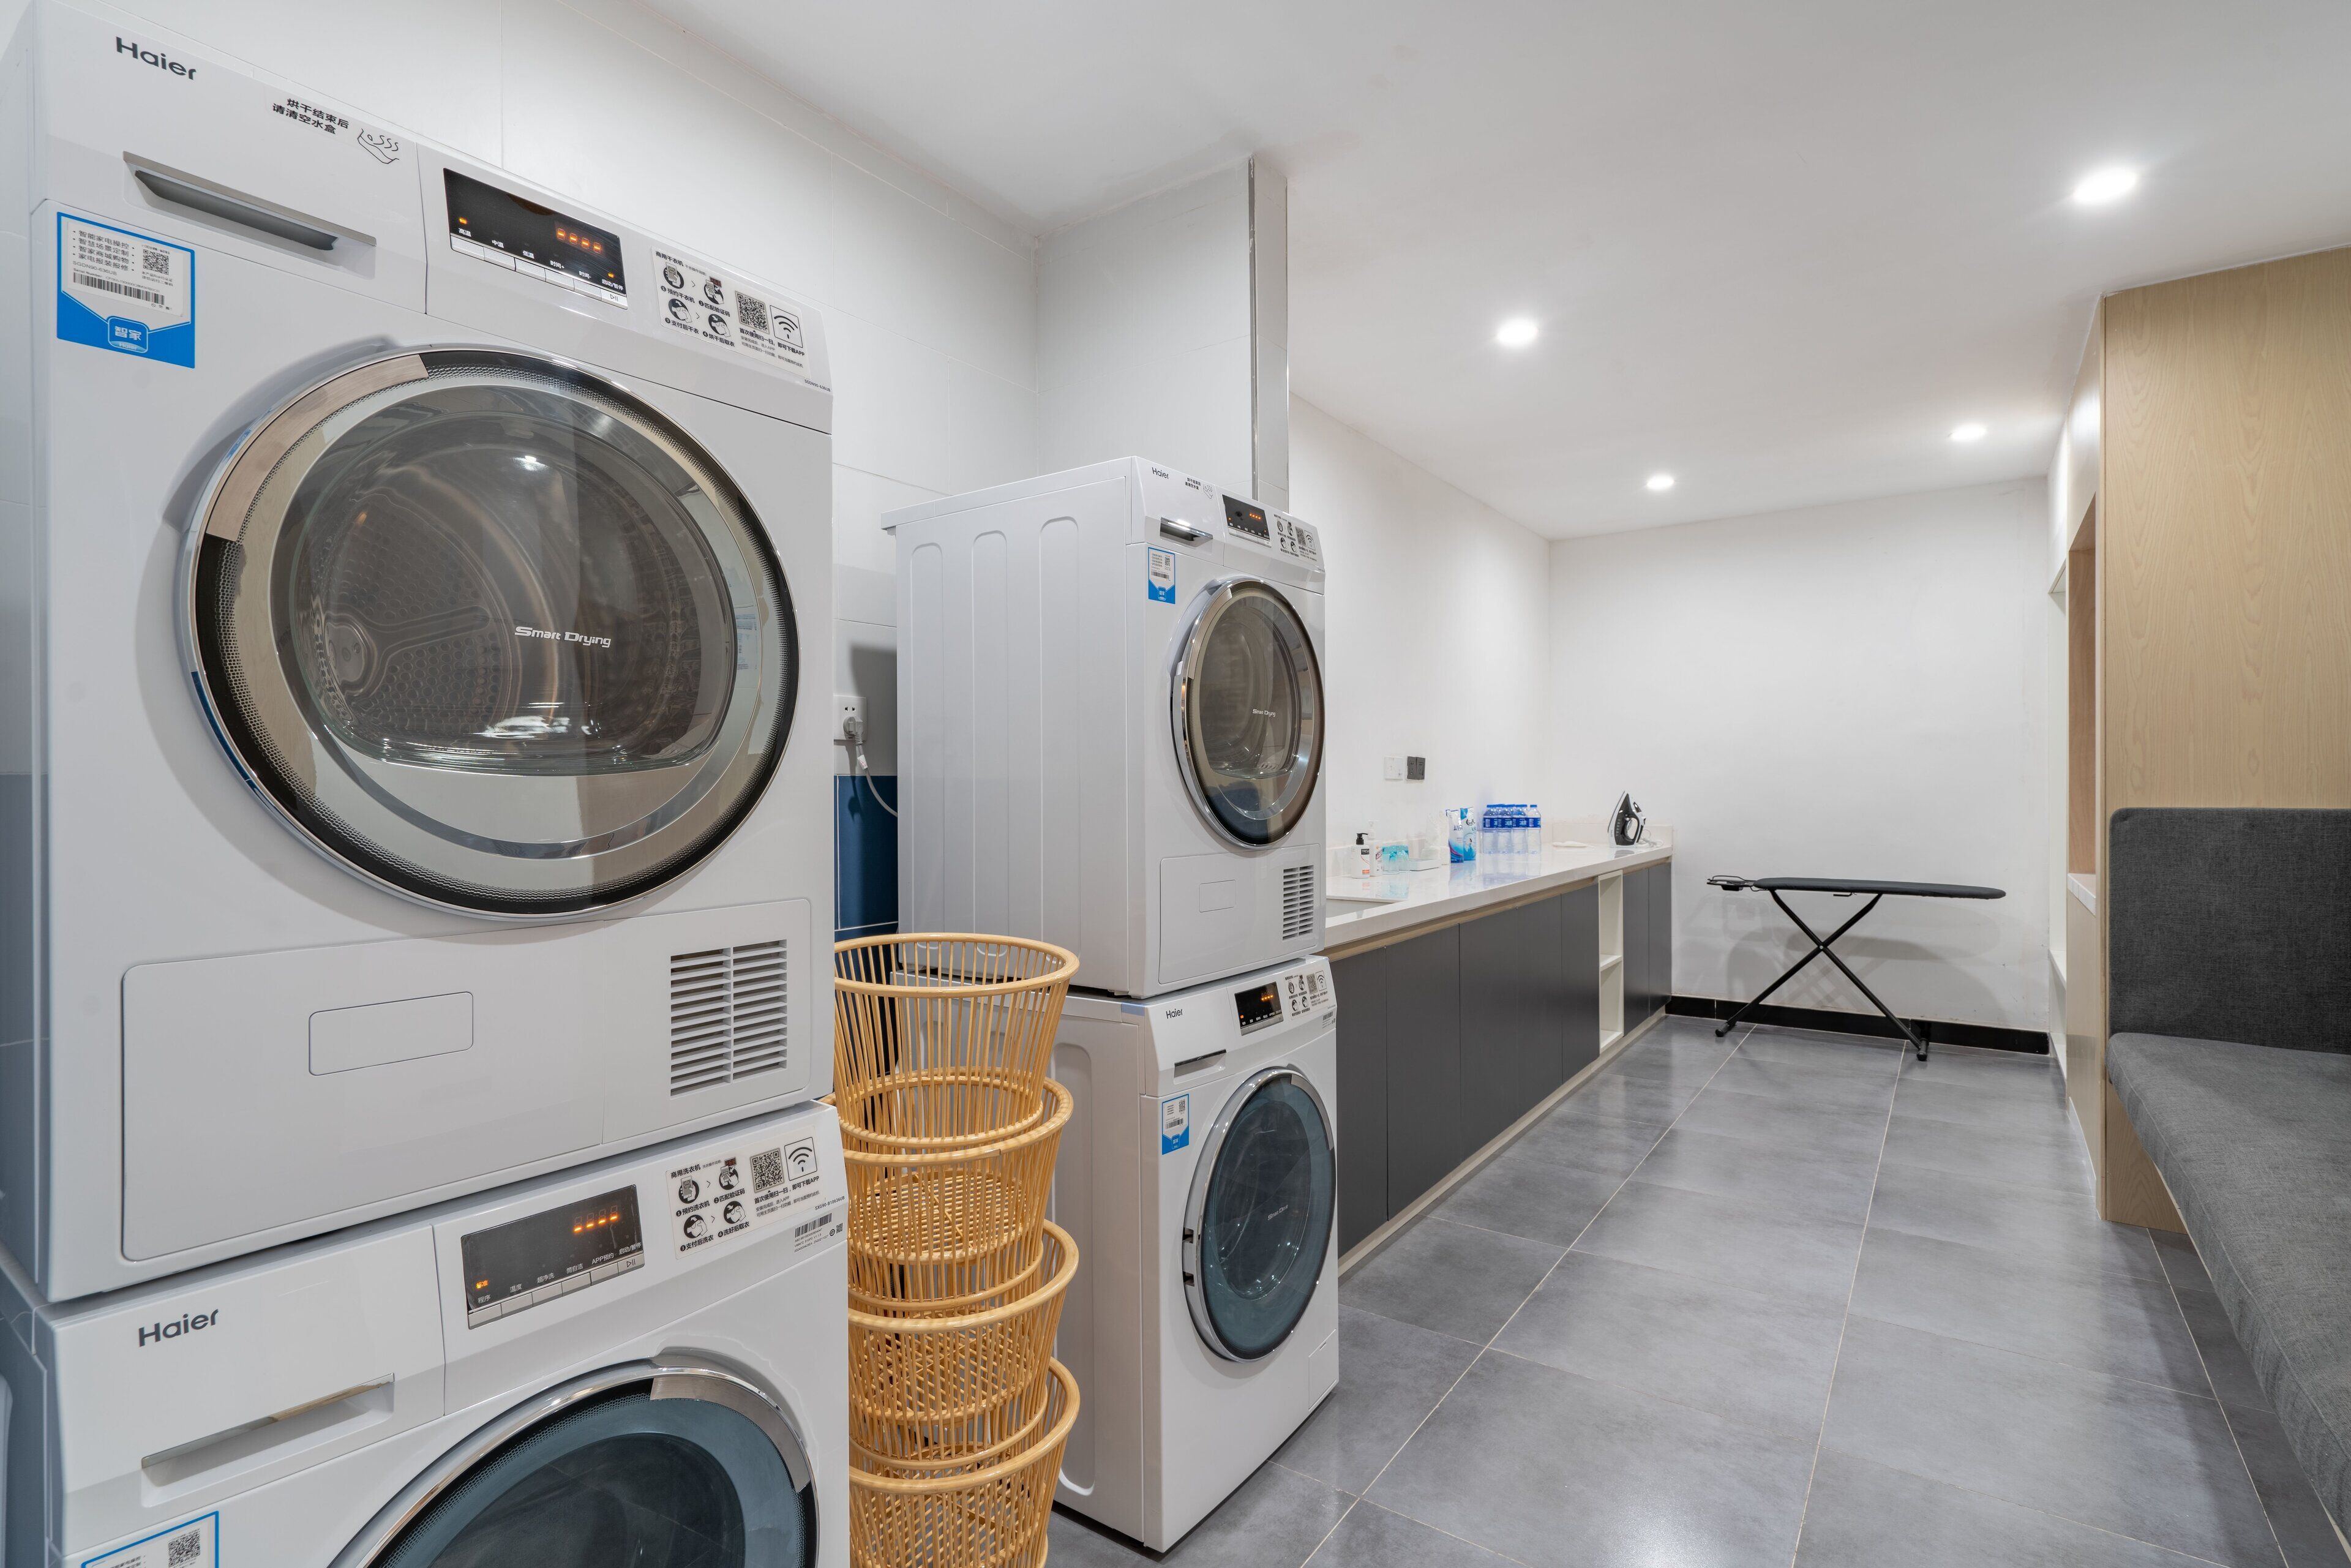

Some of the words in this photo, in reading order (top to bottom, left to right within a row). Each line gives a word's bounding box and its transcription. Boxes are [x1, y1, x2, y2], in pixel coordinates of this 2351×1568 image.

[116, 37, 197, 80] Haier
[272, 103, 337, 134] 请清空水盒
[286, 98, 350, 129] 烘干结束后
[78, 230, 129, 249] 智能家电操控
[459, 228, 471, 237] 高温
[78, 238, 129, 257] 智慧场景定制
[492, 239, 504, 249] 中温
[78, 246, 129, 264] 智家商城购物
[522, 250, 534, 259] 低温
[656, 251, 684, 267] 商用干衣机
[78, 253, 129, 271] 家电报装报修
[602, 279, 624, 291] 启动/暂停
[667, 288, 695, 304] 预约干衣机
[704, 302, 730, 317] 匹配验证码
[114, 326, 141, 340] 智家
[671, 320, 699, 334] 支付后干衣
[709, 334, 735, 347] 烘干后取衣
[1152, 467, 1169, 479] Haier
[514, 626, 561, 640] Smart
[564, 631, 611, 648] Drying
[1166, 1008, 1183, 1019] Haier
[670, 1164, 701, 1179] 商用洗衣机
[719, 1188, 745, 1202] 匹配验证码
[682, 1201, 710, 1215] 预约洗衣机
[723, 1221, 750, 1236] 洗好后取衣
[618, 1242, 642, 1255] 启动/暂停
[686, 1234, 714, 1250] 支付后洗衣
[591, 1252, 614, 1264] APP预约
[566, 1263, 583, 1274] 筒自洁
[536, 1272, 555, 1284] 超净洗
[509, 1283, 522, 1292] 温度
[478, 1294, 491, 1304] 程序
[138, 1308, 219, 1347] Haier
